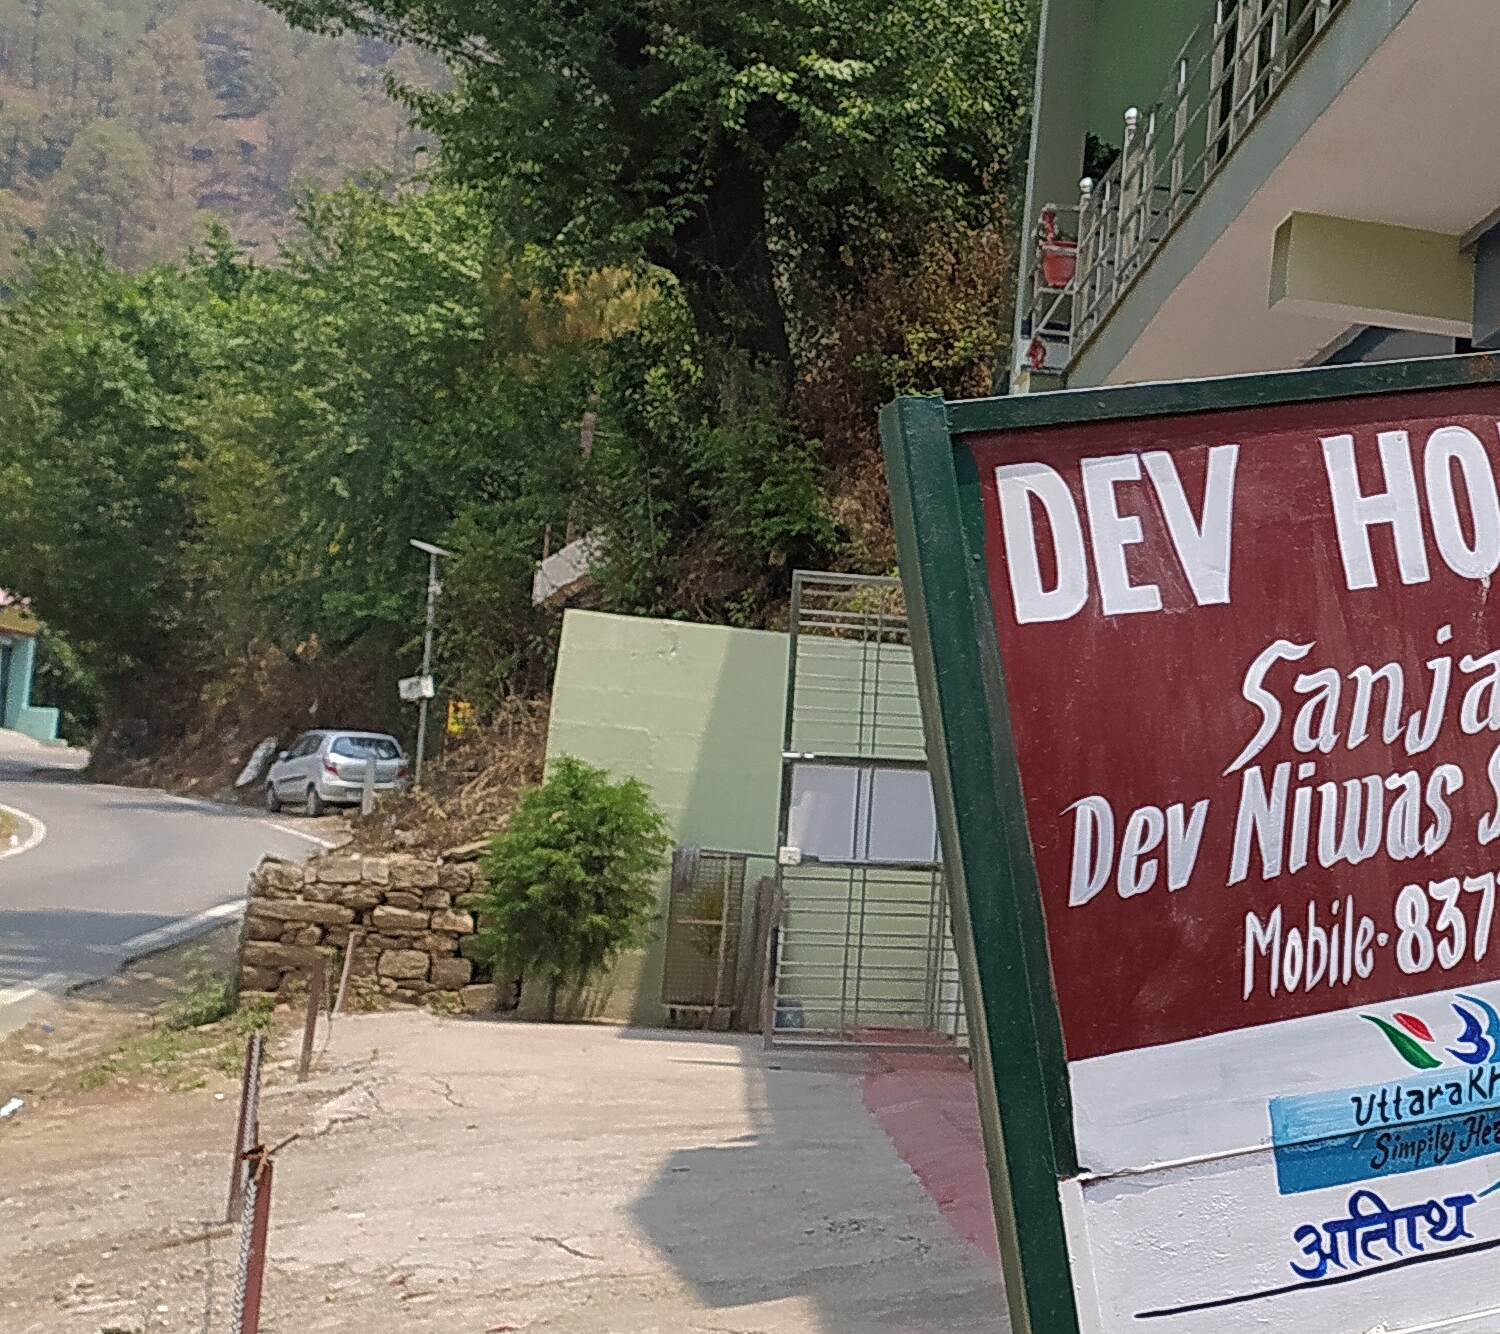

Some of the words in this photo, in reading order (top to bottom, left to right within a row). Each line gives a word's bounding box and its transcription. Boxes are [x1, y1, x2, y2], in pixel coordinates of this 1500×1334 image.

[996, 444, 1240, 624] DEV
[1060, 795, 1210, 907] Dev
[1226, 761, 1464, 887] Niwas
